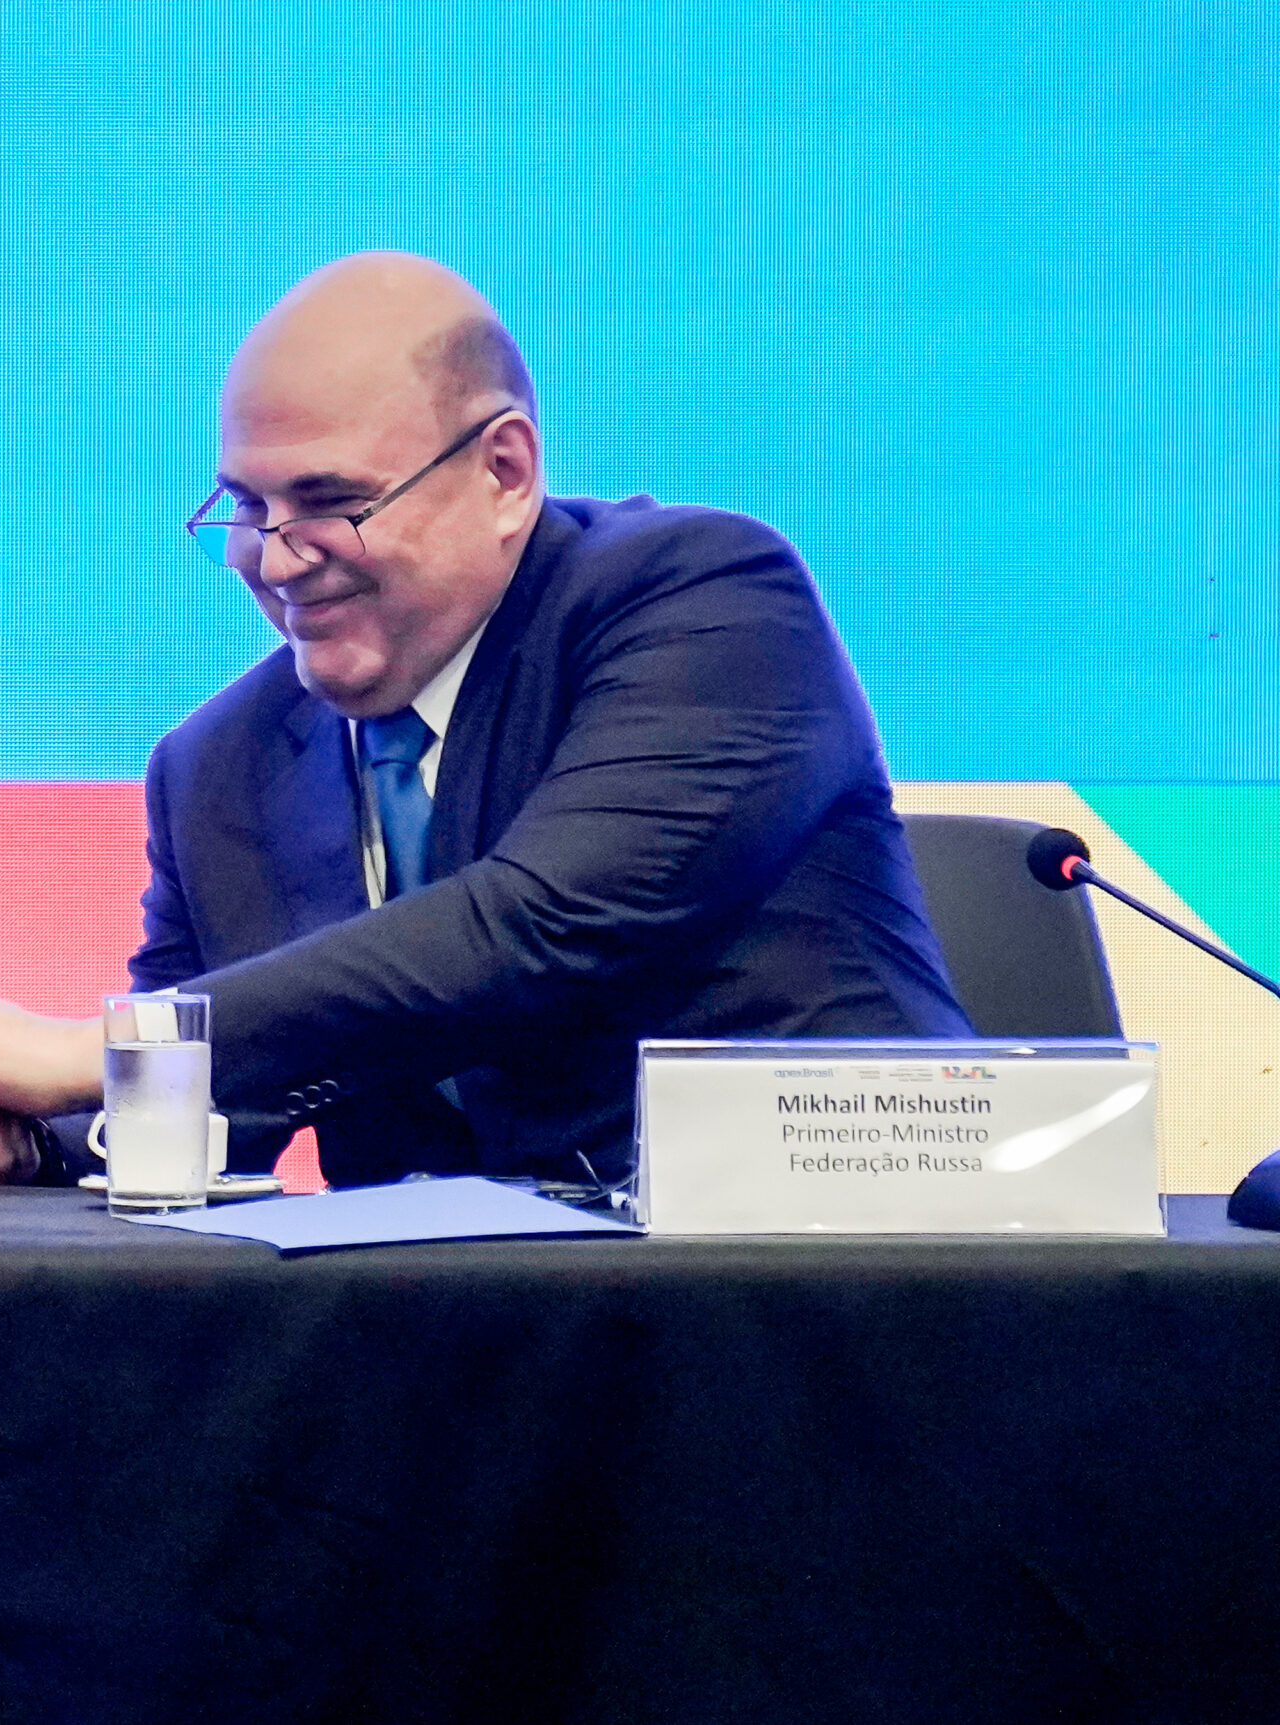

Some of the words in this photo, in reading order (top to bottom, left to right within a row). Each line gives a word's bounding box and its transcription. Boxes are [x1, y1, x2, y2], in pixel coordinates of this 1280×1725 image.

[777, 1093, 866, 1114] Mikhail
[874, 1093, 992, 1114] Mishustin
[782, 1123, 989, 1144] Primeiro-Ministro
[789, 1151, 910, 1177] Federação
[917, 1152, 983, 1173] Russa
